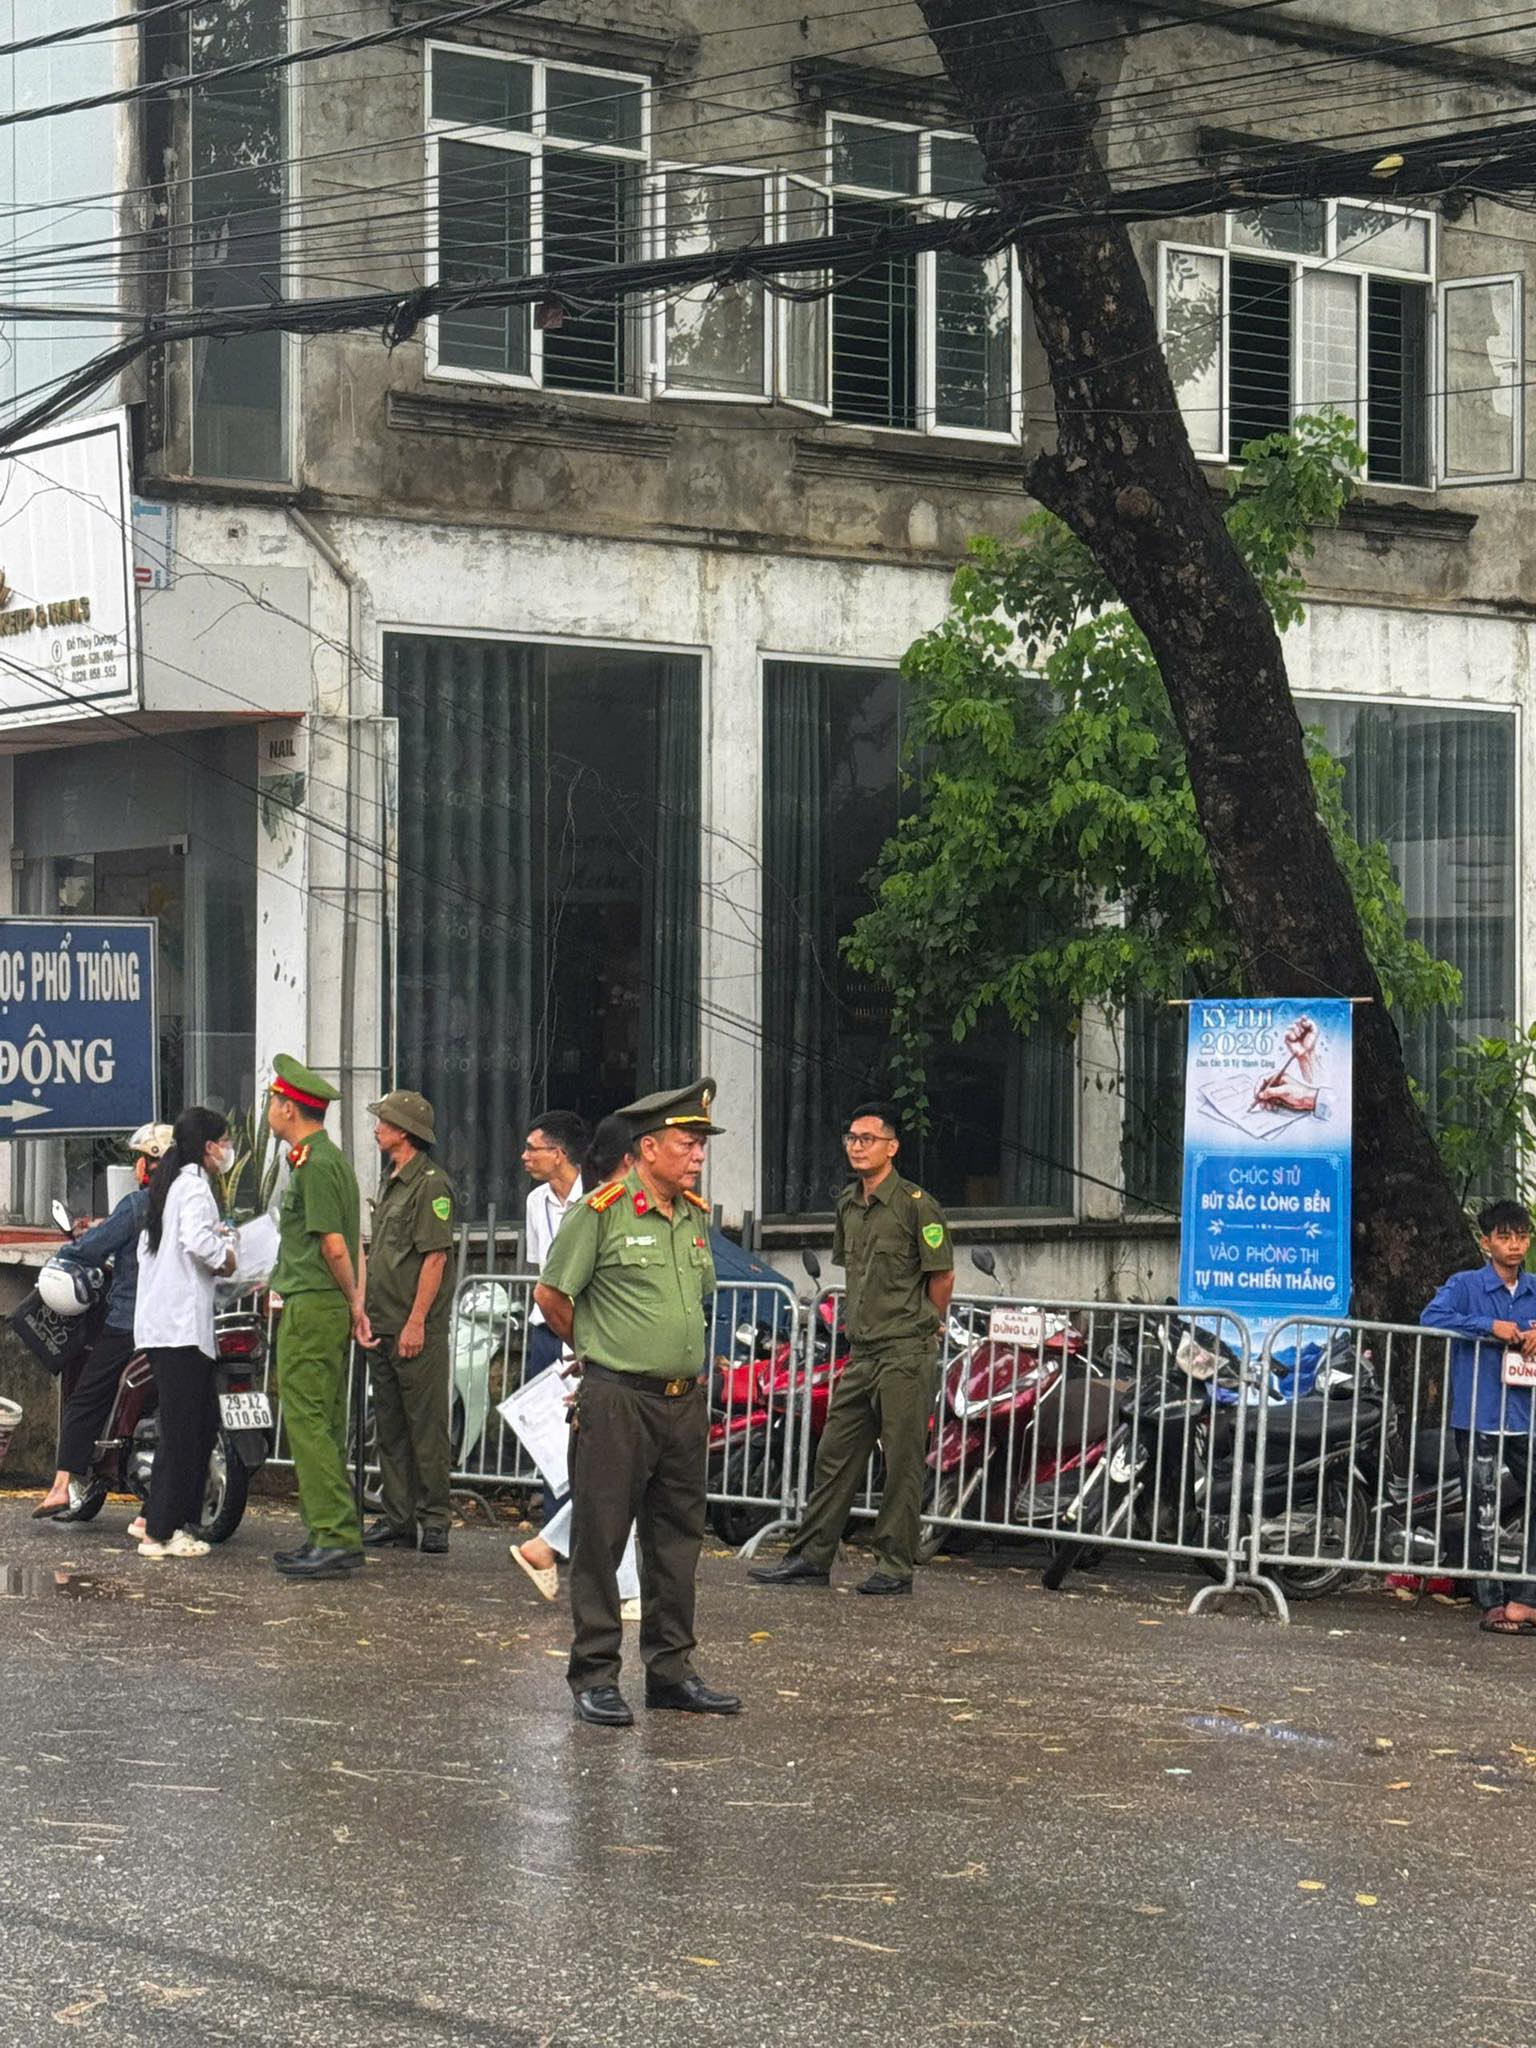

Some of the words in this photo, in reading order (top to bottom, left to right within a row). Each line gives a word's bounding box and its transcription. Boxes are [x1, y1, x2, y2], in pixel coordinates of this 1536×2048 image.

[269, 739, 296, 759] NAIL
[32, 931, 71, 1001] PHỔ
[76, 940, 140, 1001] THÔNG
[1202, 1003, 1230, 1028] KỲ
[1200, 1028, 1273, 1055] 2026
[1229, 1165, 1269, 1185] CHÚC
[1272, 1166, 1284, 1185] SĨ
[1286, 1164, 1301, 1186] TỬ
[1201, 1189, 1224, 1211] BÚT
[1226, 1188, 1257, 1211] SẮC
[1260, 1191, 1300, 1212] LÒNG
[1303, 1188, 1331, 1213] BỀN
[1209, 1242, 1240, 1262] VÀO
[1246, 1243, 1298, 1264] PHÒNG
[1301, 1247, 1320, 1265] THI
[1195, 1269, 1211, 1290] TỰ
[1212, 1271, 1234, 1288] TIN
[1238, 1266, 1282, 1289] CHIẾN
[1284, 1267, 1336, 1291] THẮNG
[225, 1410, 270, 1427] 010.60
